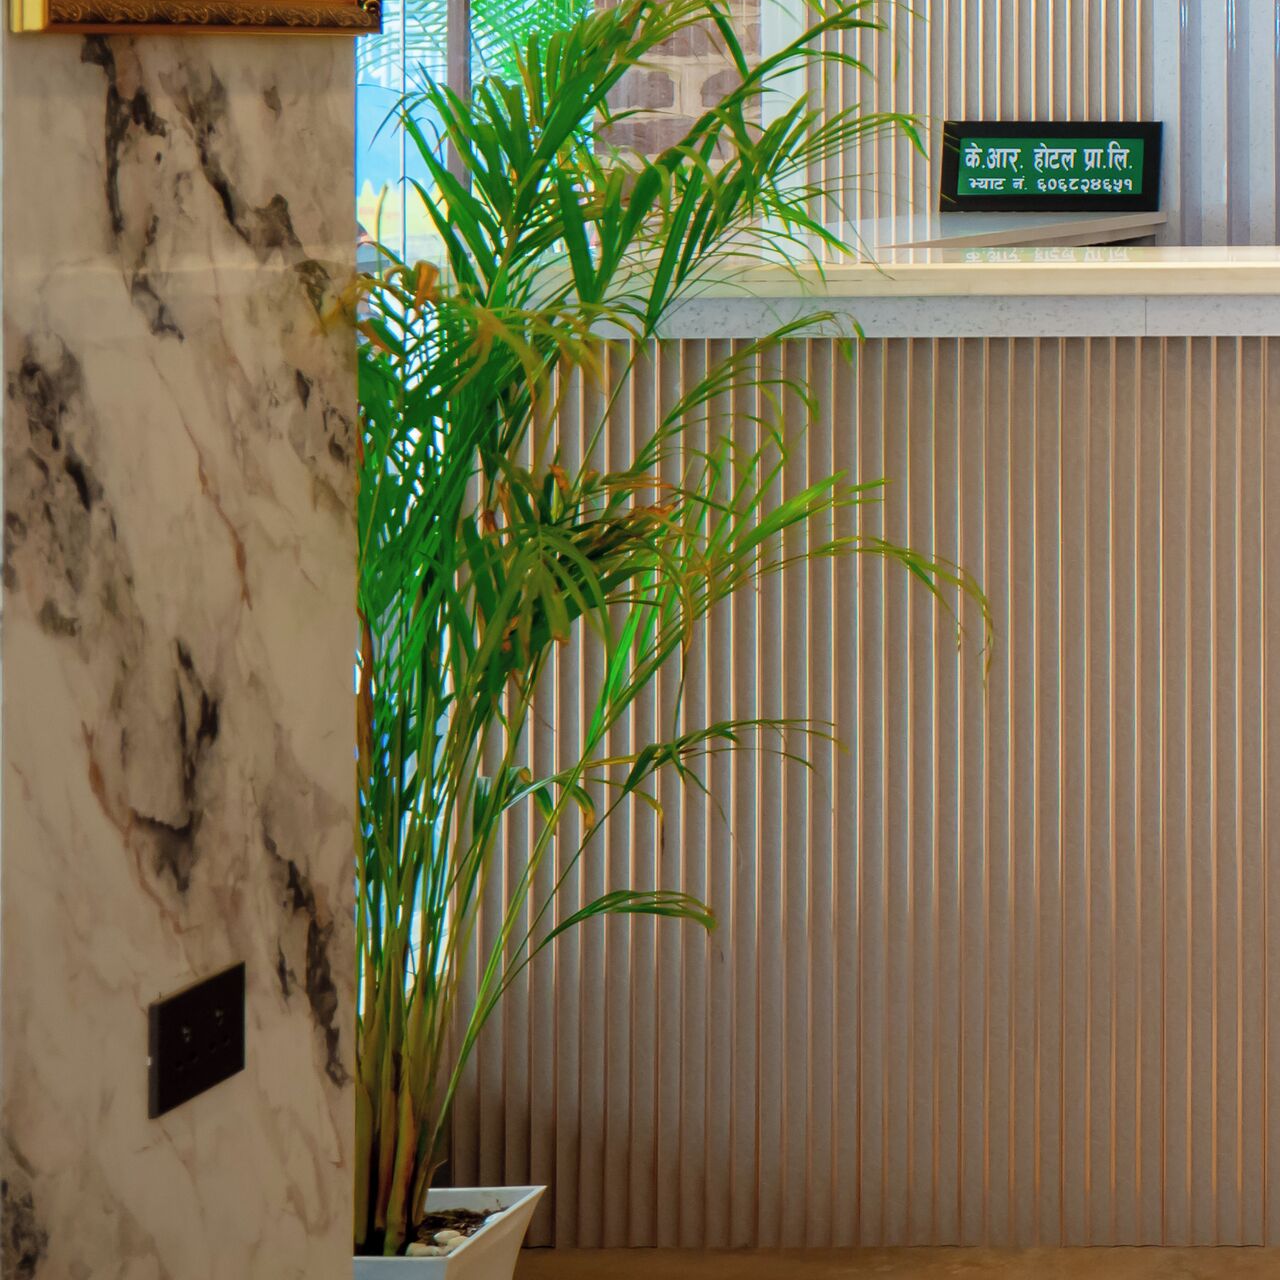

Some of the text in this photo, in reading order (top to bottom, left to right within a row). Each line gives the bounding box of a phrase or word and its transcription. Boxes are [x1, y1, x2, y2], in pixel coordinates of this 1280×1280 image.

[965, 140, 1133, 173] के.आर. होटल प्रा.लि.
[969, 178, 1006, 191] भ्याट
[1037, 178, 1133, 193] ६०६८२४६५१
